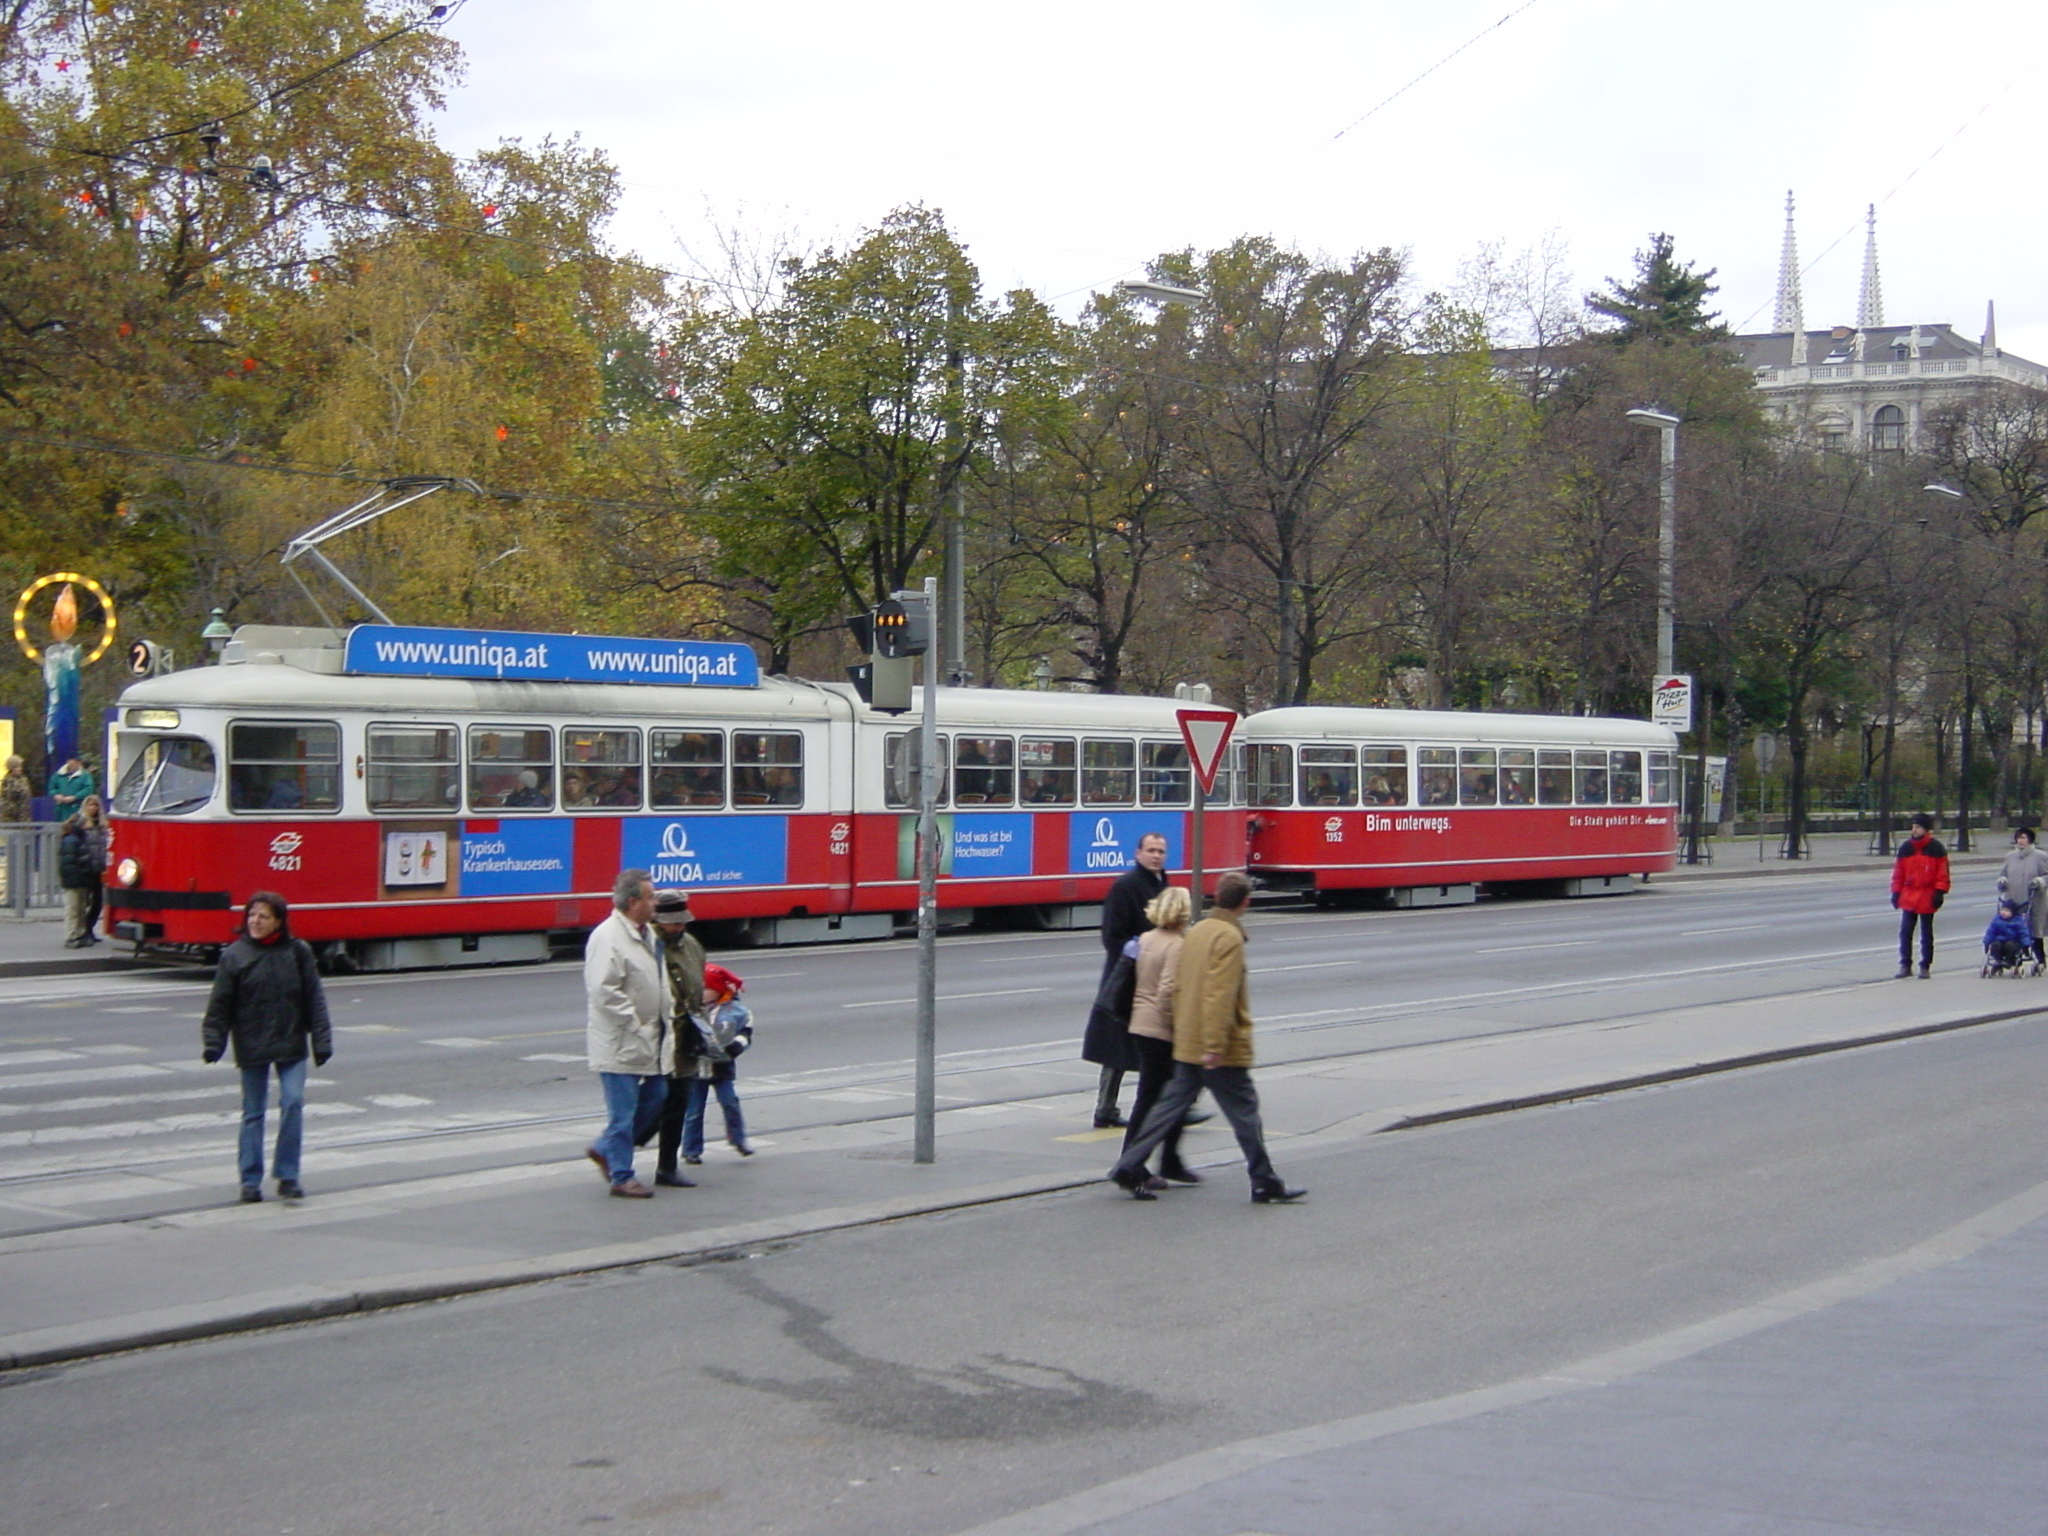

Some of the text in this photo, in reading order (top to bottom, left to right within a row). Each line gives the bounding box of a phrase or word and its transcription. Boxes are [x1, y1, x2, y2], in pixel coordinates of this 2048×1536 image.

[133, 644, 147, 673] 2
[375, 637, 548, 675] www.uniqa.at
[587, 648, 737, 683] www.uniqa.at
[1656, 690, 1688, 705] Pizza
[1662, 698, 1684, 709] Hut
[1366, 814, 1452, 834] Bim unterwegs.
[1569, 815, 1582, 827] Die
[1584, 815, 1603, 826] Stadt
[955, 831, 1012, 843] Und was ist bei
[1326, 832, 1343, 843] 1352
[463, 840, 505, 858] Typisch
[830, 842, 849, 855] 4821
[954, 844, 1004, 858] Hochwasser?
[268, 854, 302, 871] 4821
[463, 856, 563, 873] Krankenhausessen.
[1086, 851, 1125, 868] UNIQA
[650, 862, 704, 883] UNIQA
